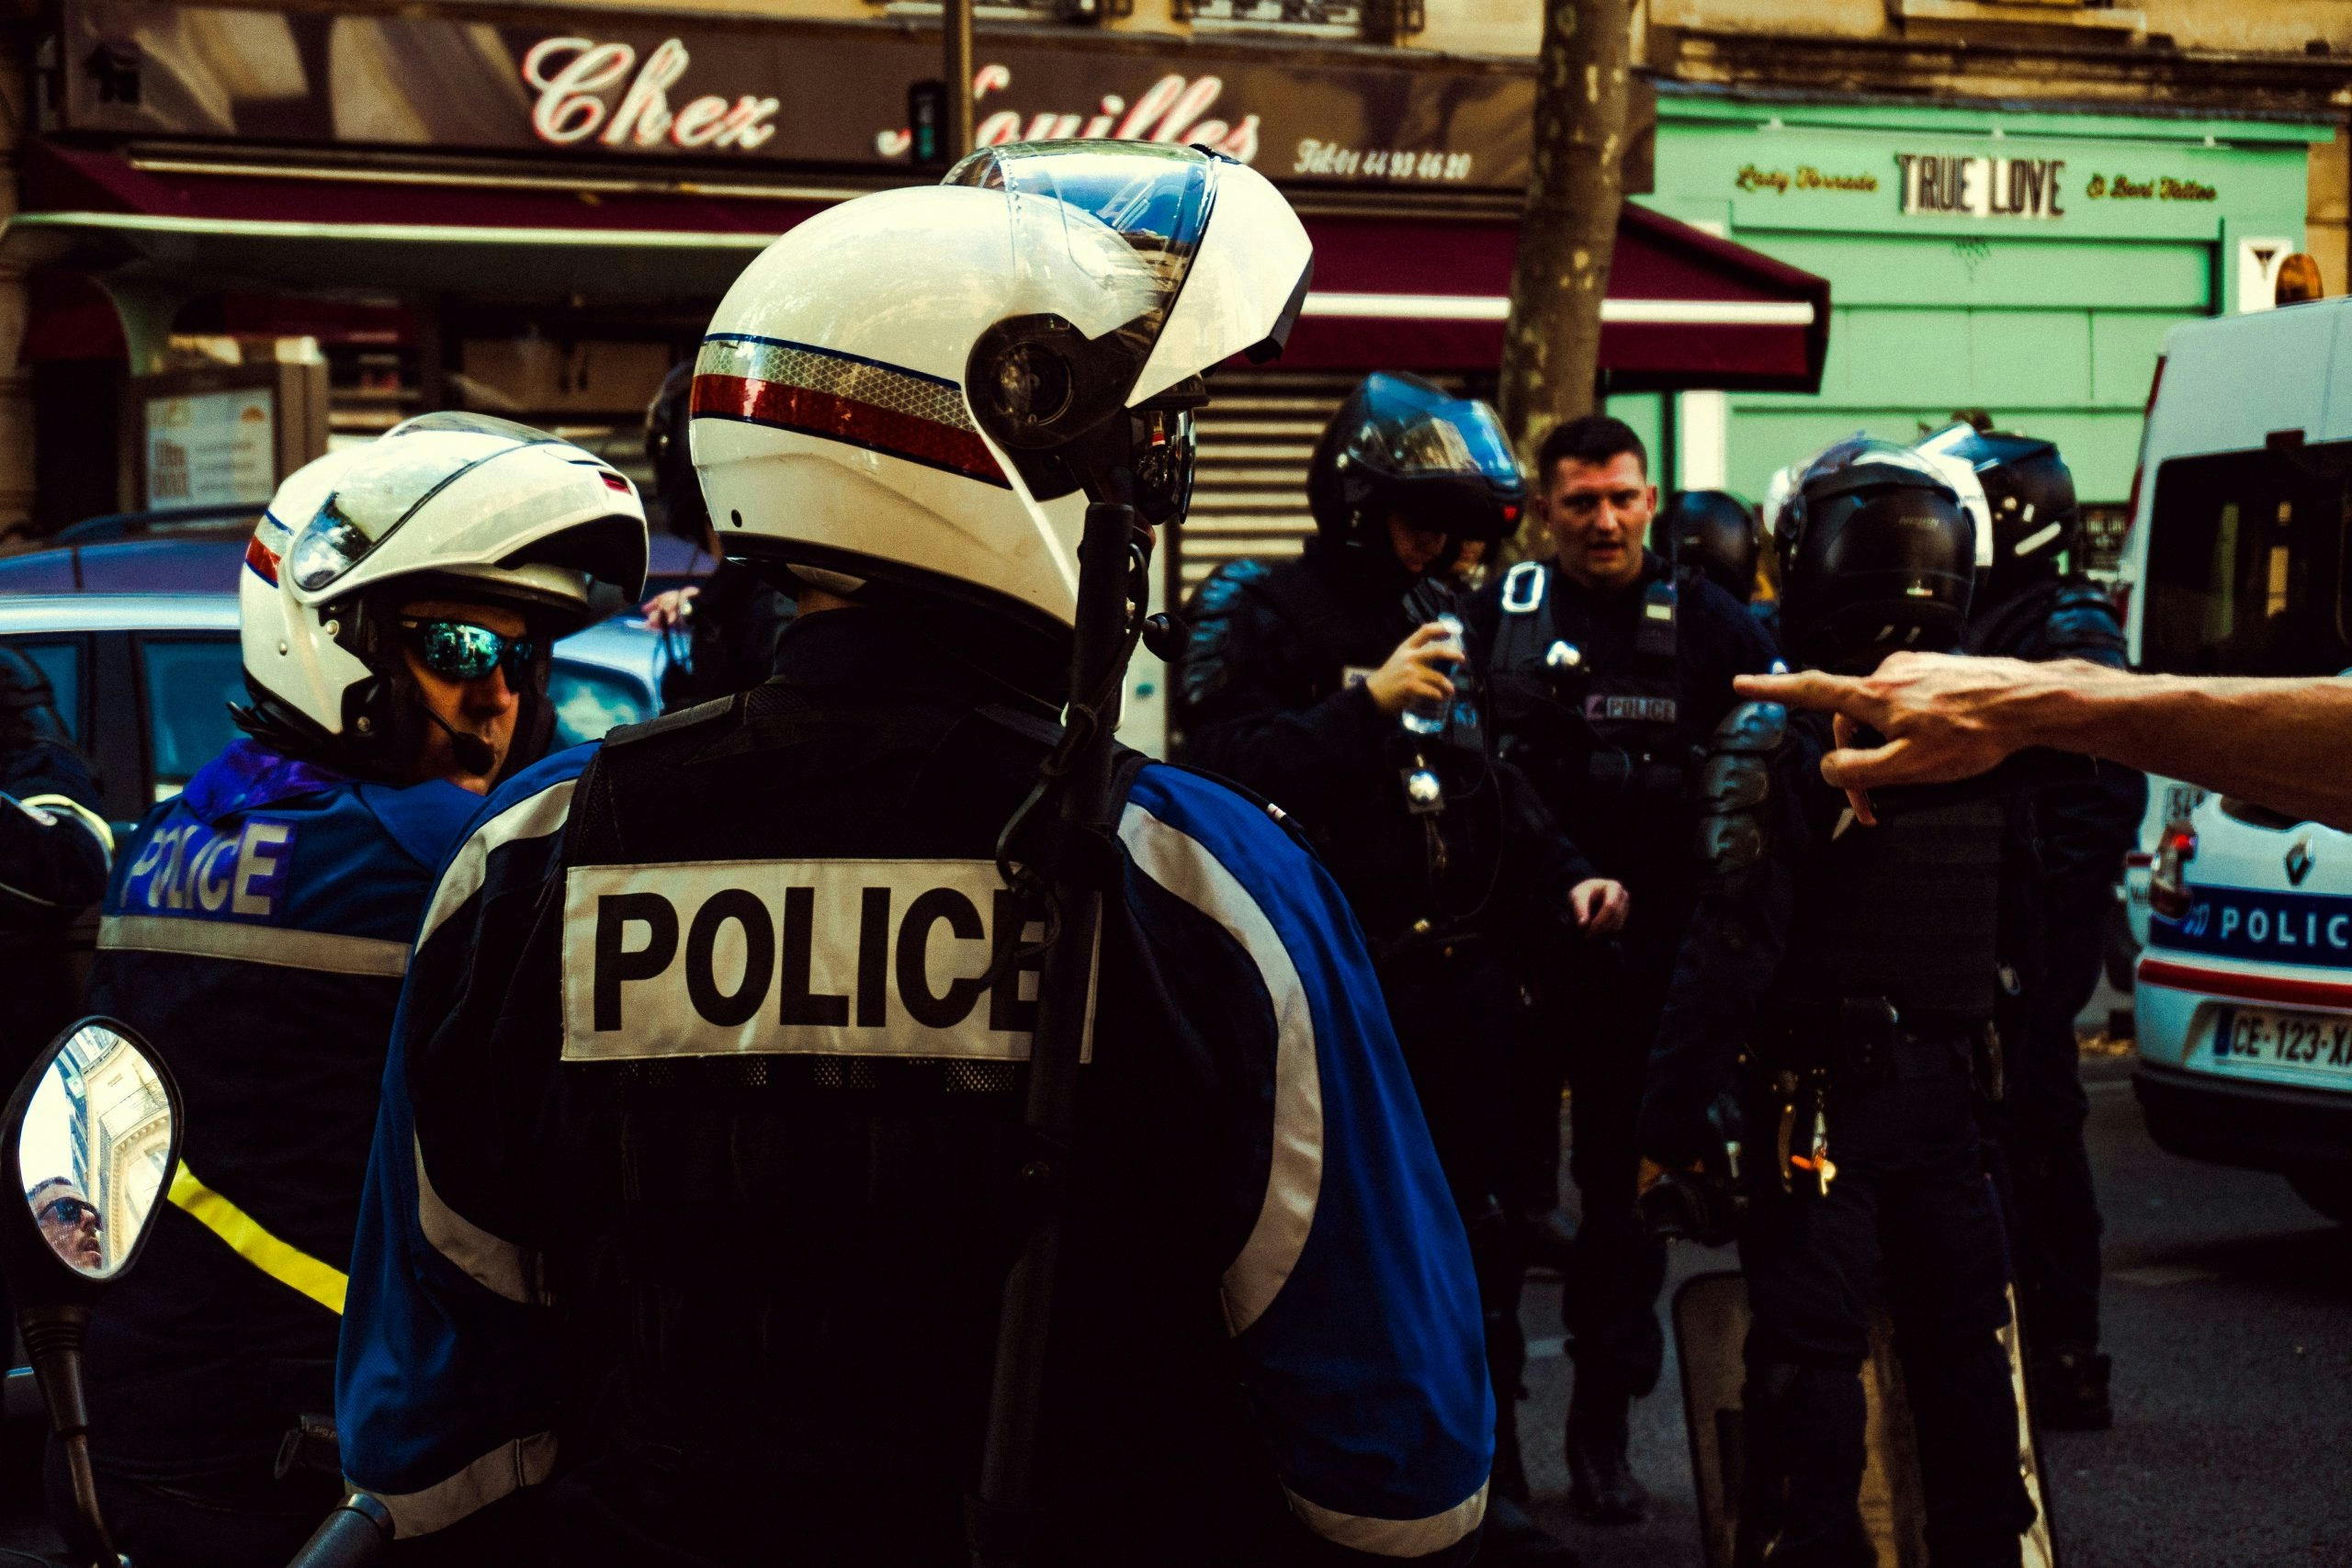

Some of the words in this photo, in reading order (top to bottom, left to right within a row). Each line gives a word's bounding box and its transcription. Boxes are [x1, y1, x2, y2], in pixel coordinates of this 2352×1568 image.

[523, 38, 779, 149] Chez
[1894, 154, 1975, 213] TRUE
[1988, 157, 2065, 217] LOVE
[119, 823, 289, 916] POLICE
